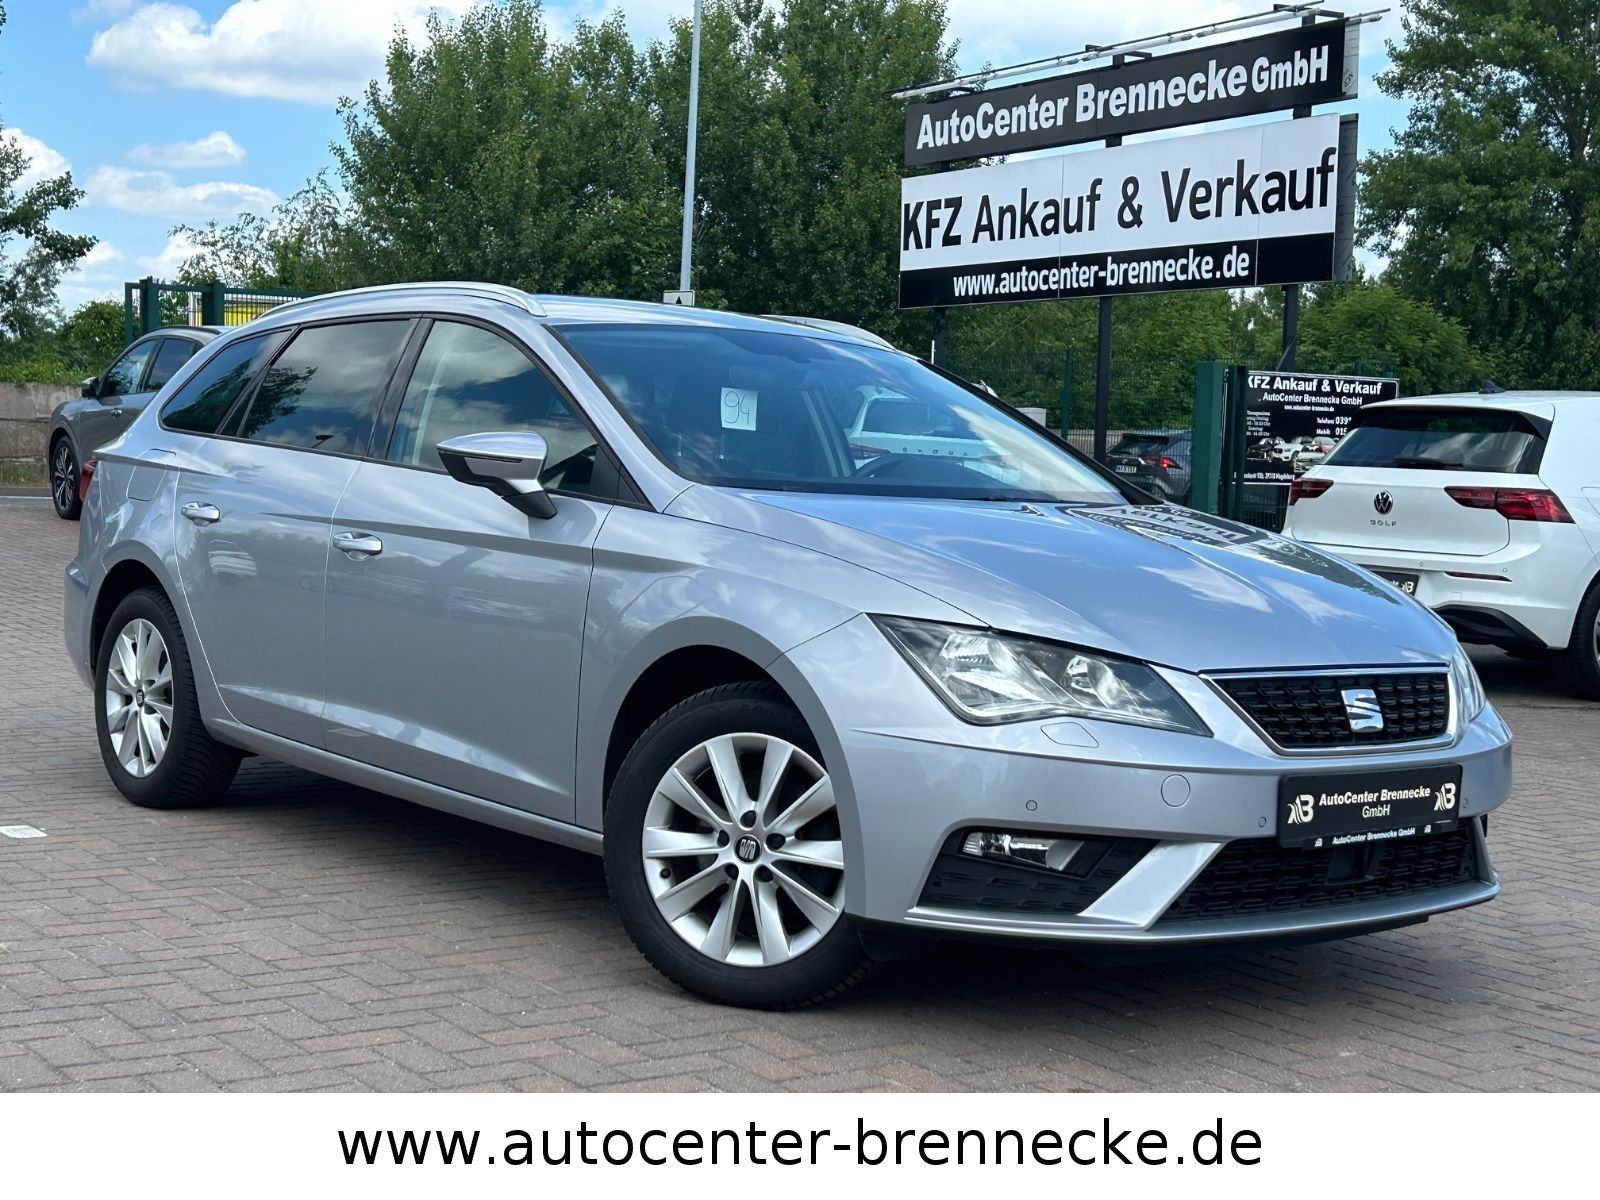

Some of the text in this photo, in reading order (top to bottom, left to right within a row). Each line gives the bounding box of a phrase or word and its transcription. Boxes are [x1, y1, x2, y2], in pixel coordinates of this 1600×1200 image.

[916, 44, 1329, 150] AutoCenter Brennecke GmbH
[903, 147, 1337, 251] KFZ Ankauf & Verkauf
[953, 245, 1250, 298] www.autocenter-brennecke.de
[1273, 376, 1318, 391] Ankauf
[1321, 379, 1331, 392] &
[1334, 380, 1382, 395] Verkauf
[1262, 391, 1363, 405] AutoCenter Brennecke GmbH
[1369, 519, 1397, 527] GOLF
[1319, 790, 1378, 806] AutoCenter
[1380, 785, 1431, 801] Brennecke
[1362, 804, 1390, 818] GmbH
[1332, 834, 1367, 845] AutoCenter
[1367, 830, 1397, 840] Brennecke
[1398, 827, 1415, 837] GmbH
